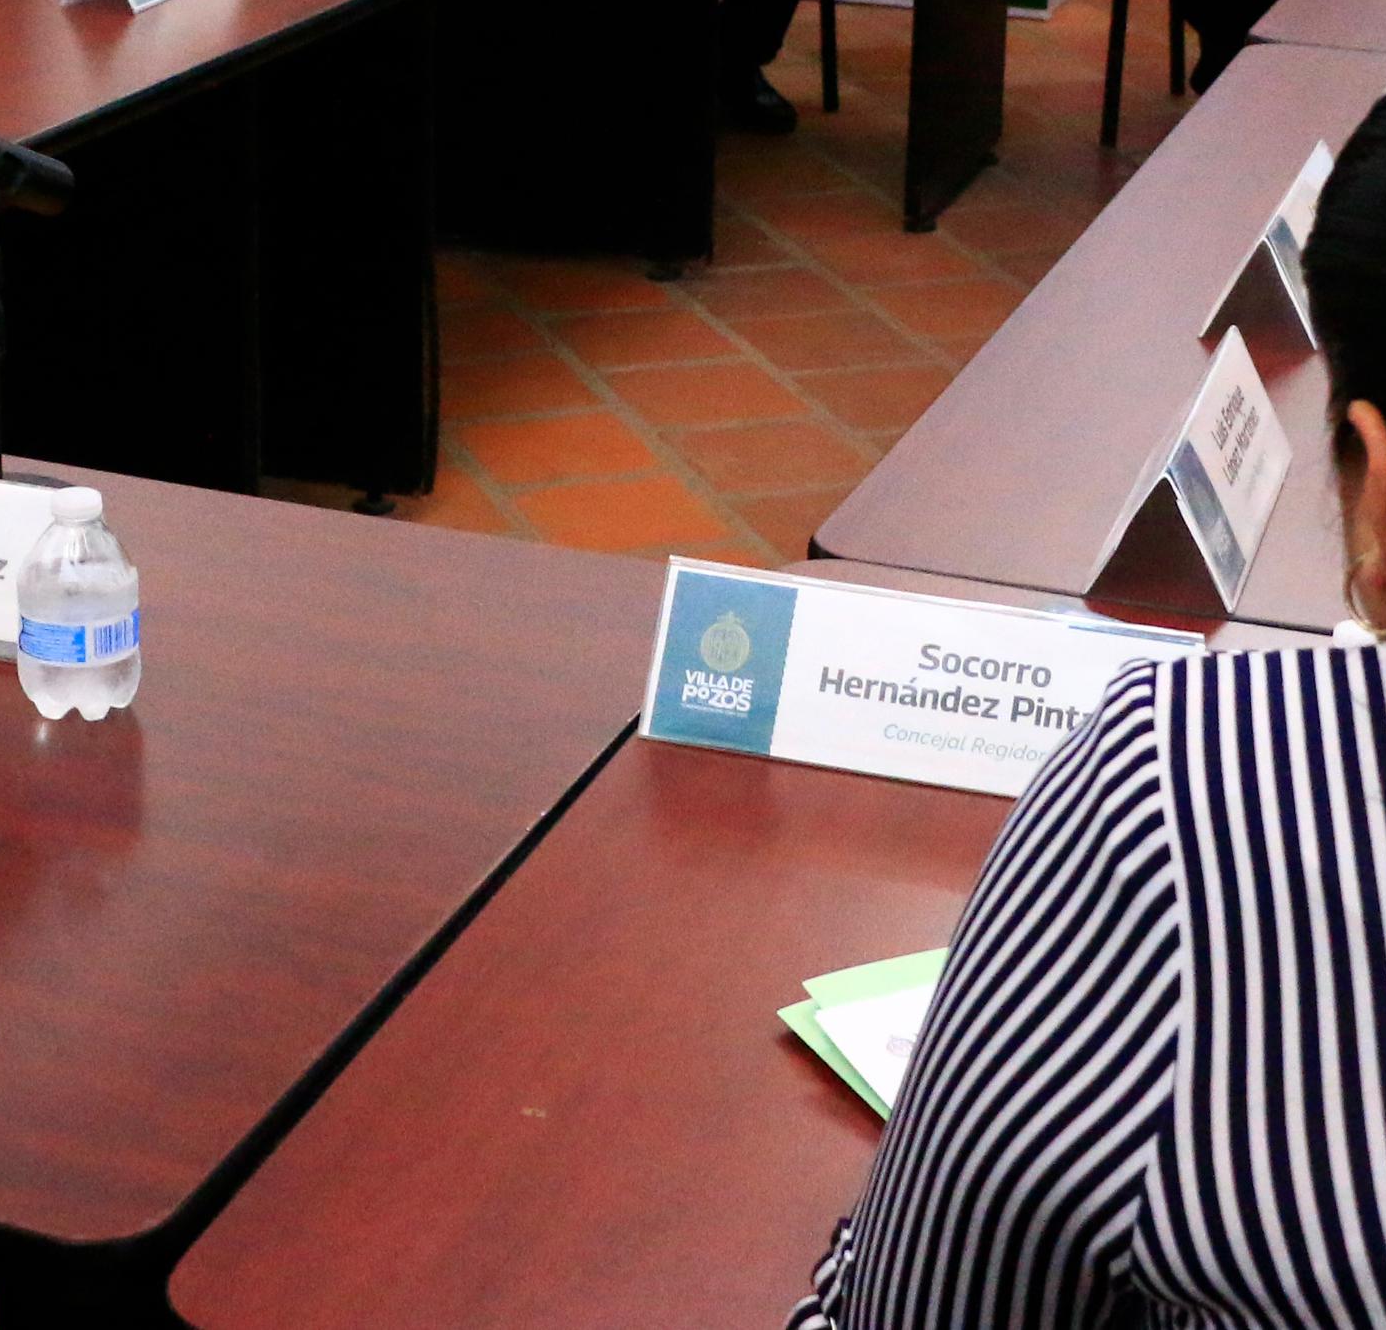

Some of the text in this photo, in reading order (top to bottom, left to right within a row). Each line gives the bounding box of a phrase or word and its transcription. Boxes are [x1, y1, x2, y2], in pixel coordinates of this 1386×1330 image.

[917, 642, 1053, 689] Socorro
[685, 669, 754, 694] VILLA DE
[681, 683, 752, 712] POZOS
[818, 666, 1094, 732] Hernández Pint
[883, 723, 966, 752] Concejal
